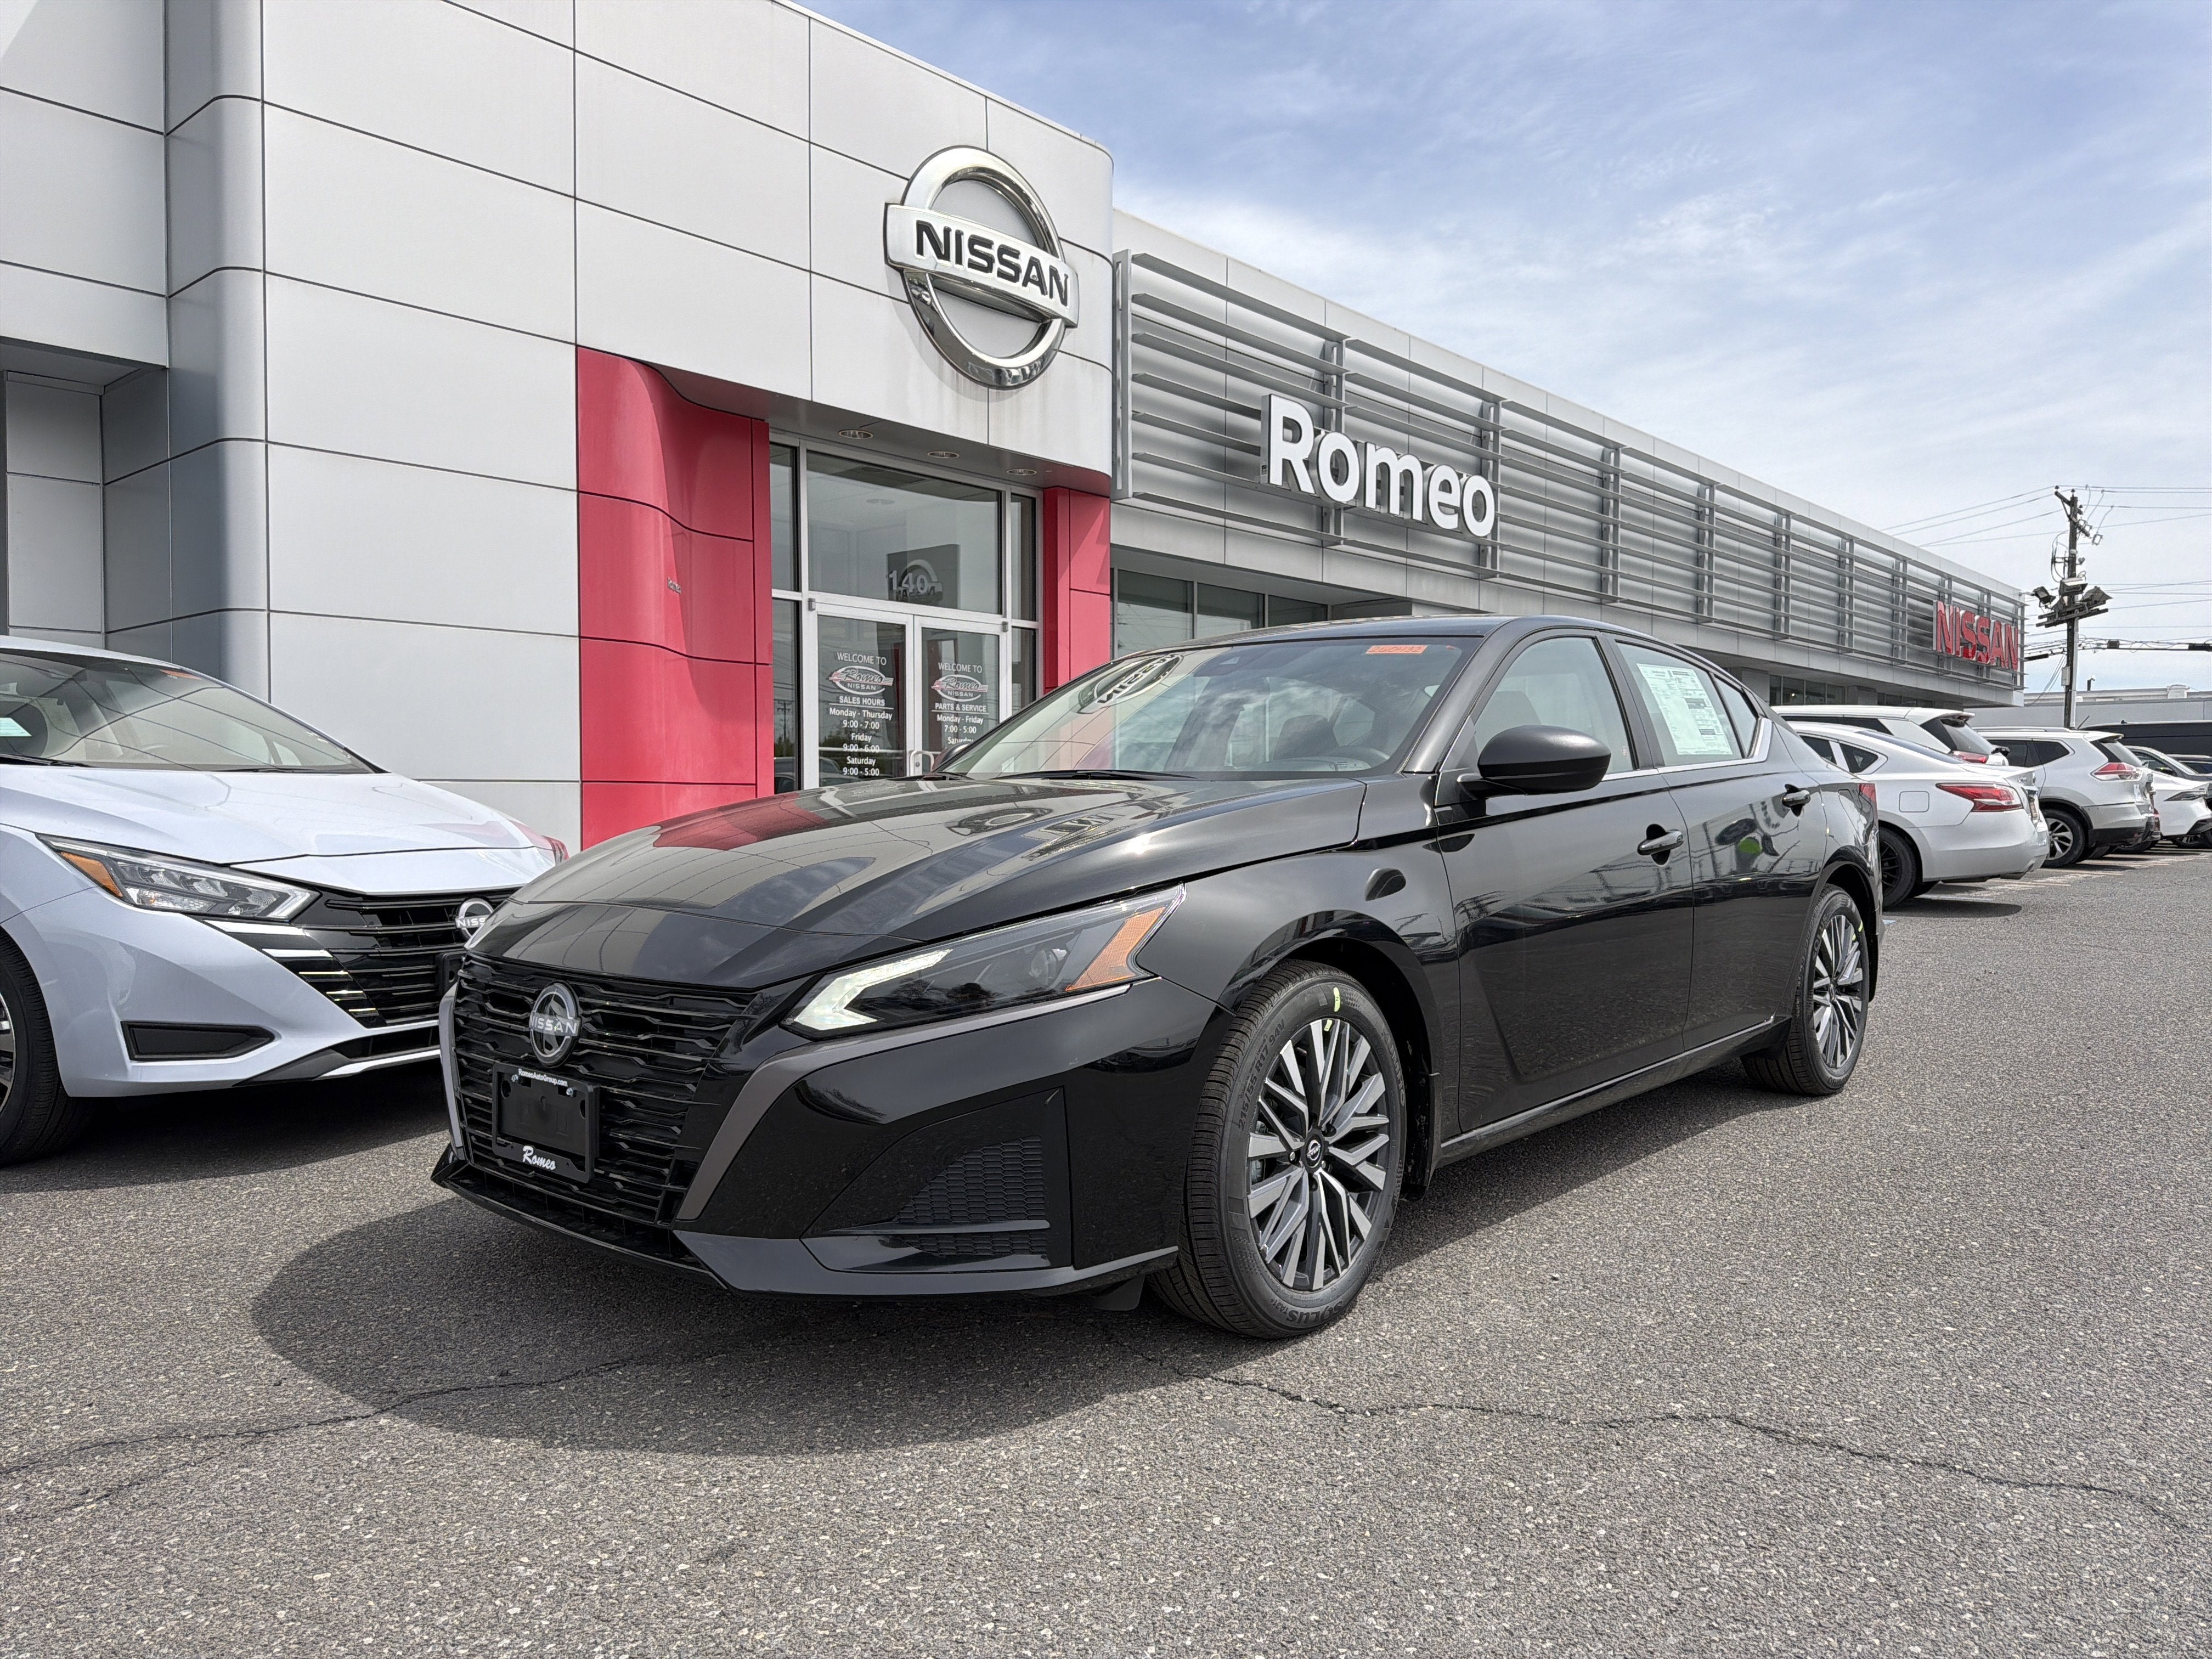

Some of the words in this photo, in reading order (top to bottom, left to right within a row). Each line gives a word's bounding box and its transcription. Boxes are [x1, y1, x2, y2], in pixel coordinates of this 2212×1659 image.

[916, 219, 1069, 308] NISSAN
[1268, 393, 1496, 537] Romeo
[889, 570, 928, 594] 140
[1936, 601, 2018, 671] NISSAN
[837, 652, 874, 664] WELCOME
[876, 656, 887, 665] TO
[938, 662, 972, 673] WELCOME
[972, 665, 983, 674] TO
[844, 668, 883, 683] Romeo
[944, 676, 979, 690] Romeo
[839, 695, 861, 704] SALES
[862, 697, 885, 707] HOURS
[830, 707, 856, 718] Monday
[862, 709, 893, 721] Thursday
[936, 714, 961, 724] Monday
[966, 715, 984, 725] Friday
[843, 719, 859, 728] 9:00
[865, 721, 880, 730] 7:00
[944, 725, 958, 733] 7:00
[851, 732, 872, 743] Friday
[843, 743, 859, 752] 9:00
[864, 744, 880, 753] 6:00
[847, 756, 876, 766] Saturday
[843, 767, 859, 775] 9:00
[865, 768, 880, 776] 5:00
[457, 918, 486, 927] NISS
[529, 1014, 577, 1034] NISSAN
[518, 1068, 568, 1087] RomeoAutoGroup.com
[1238, 1074, 1257, 1131] 215/55
[1255, 1045, 1268, 1073] R17
[1269, 1019, 1285, 1046] 94V
[522, 1146, 556, 1170] Romeo
